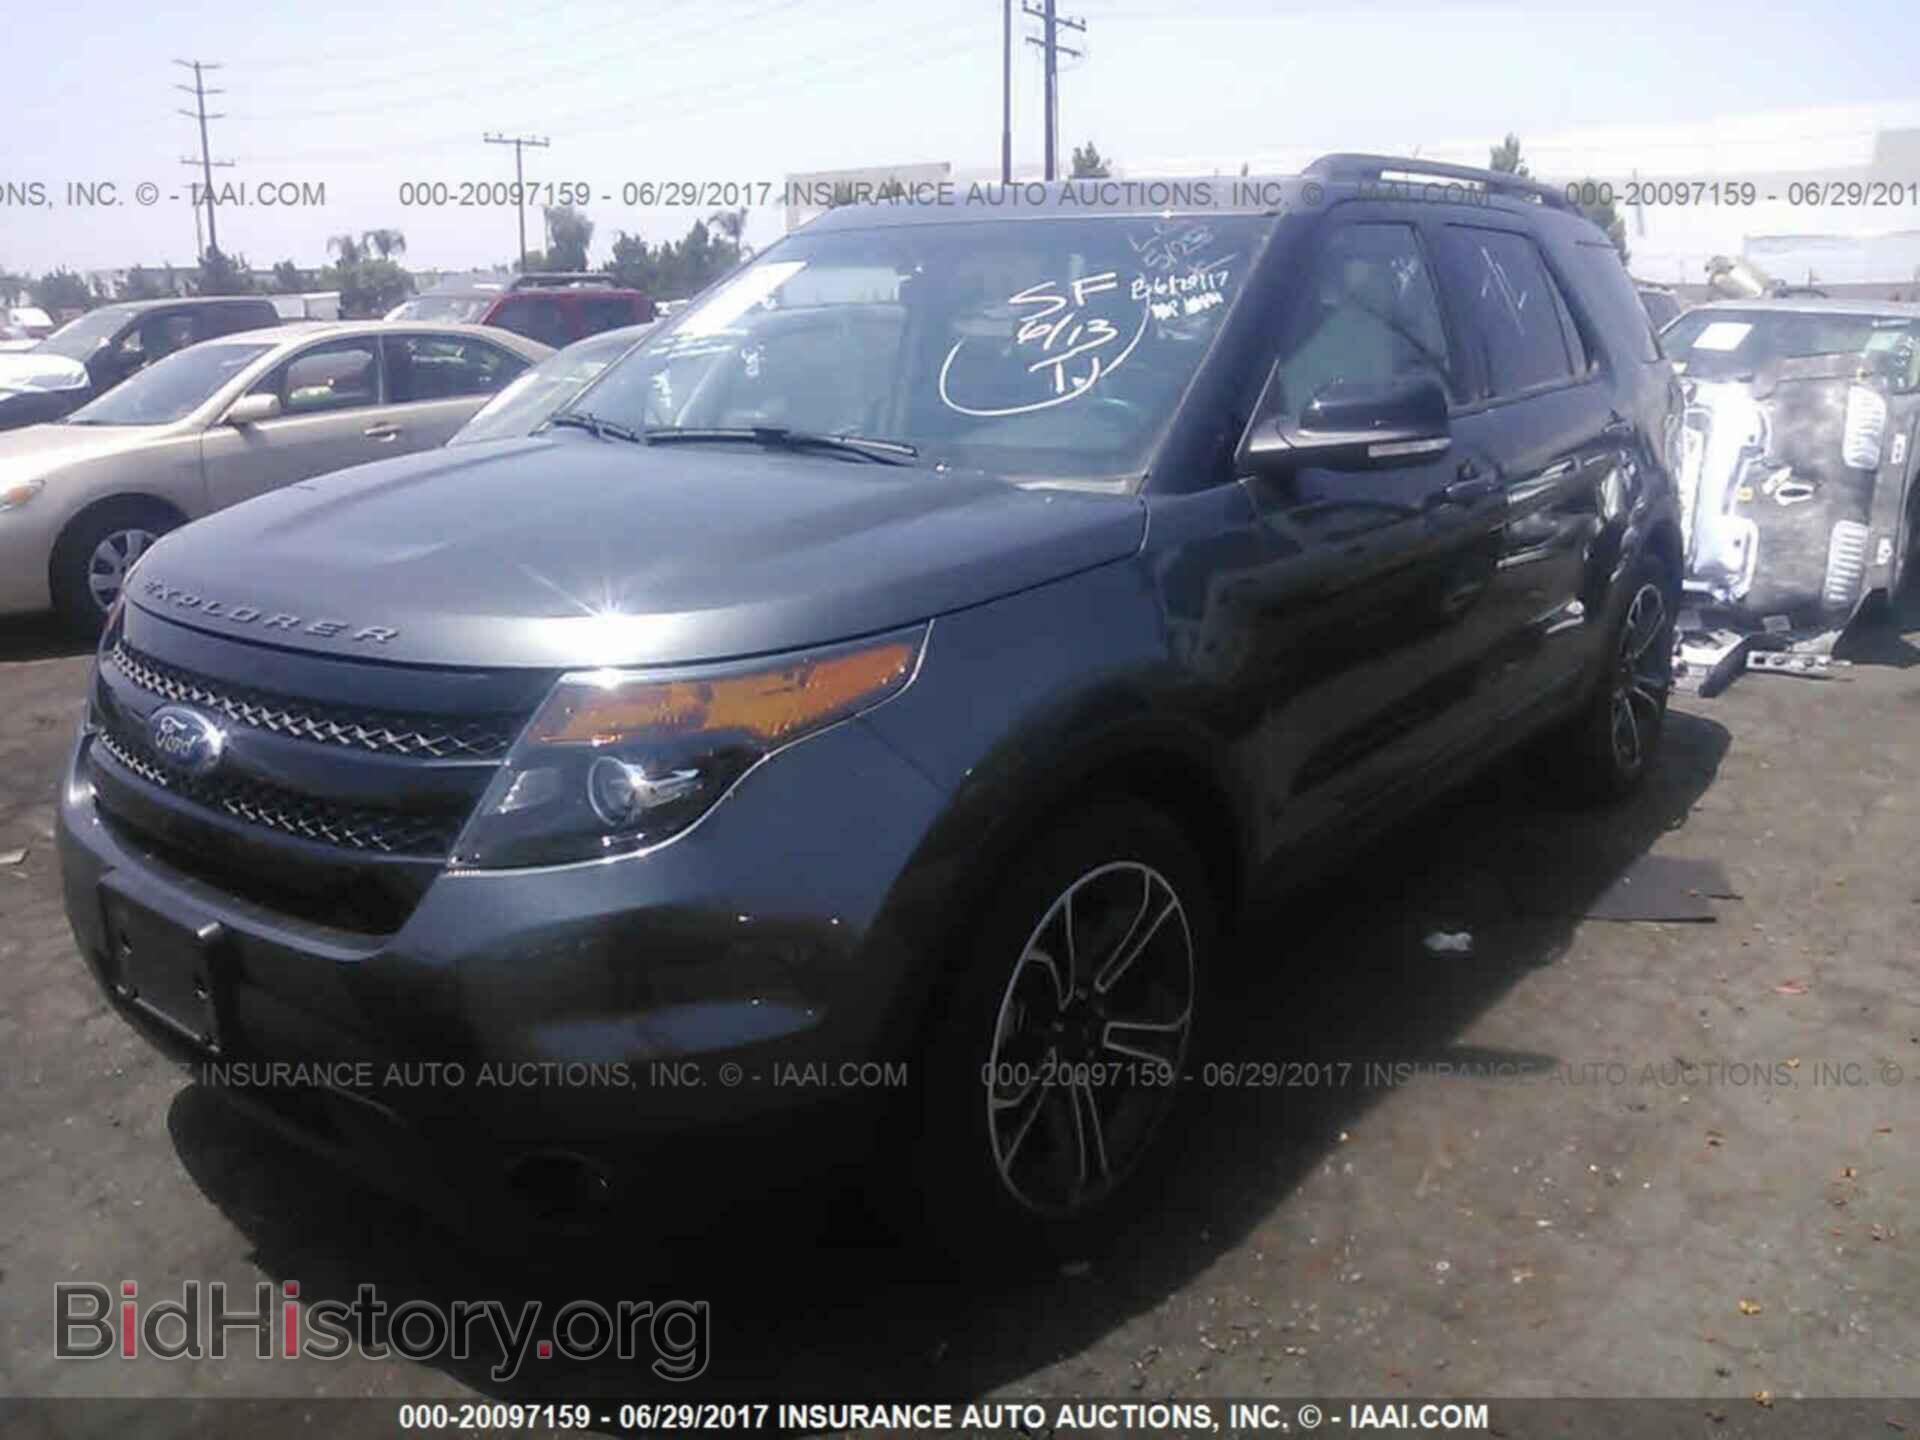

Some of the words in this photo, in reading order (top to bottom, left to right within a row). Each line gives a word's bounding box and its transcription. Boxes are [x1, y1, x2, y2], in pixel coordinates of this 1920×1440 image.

[1008, 272, 1117, 321] SF
[1016, 312, 1118, 351] 6/13
[143, 576, 399, 644] EXPLORER
